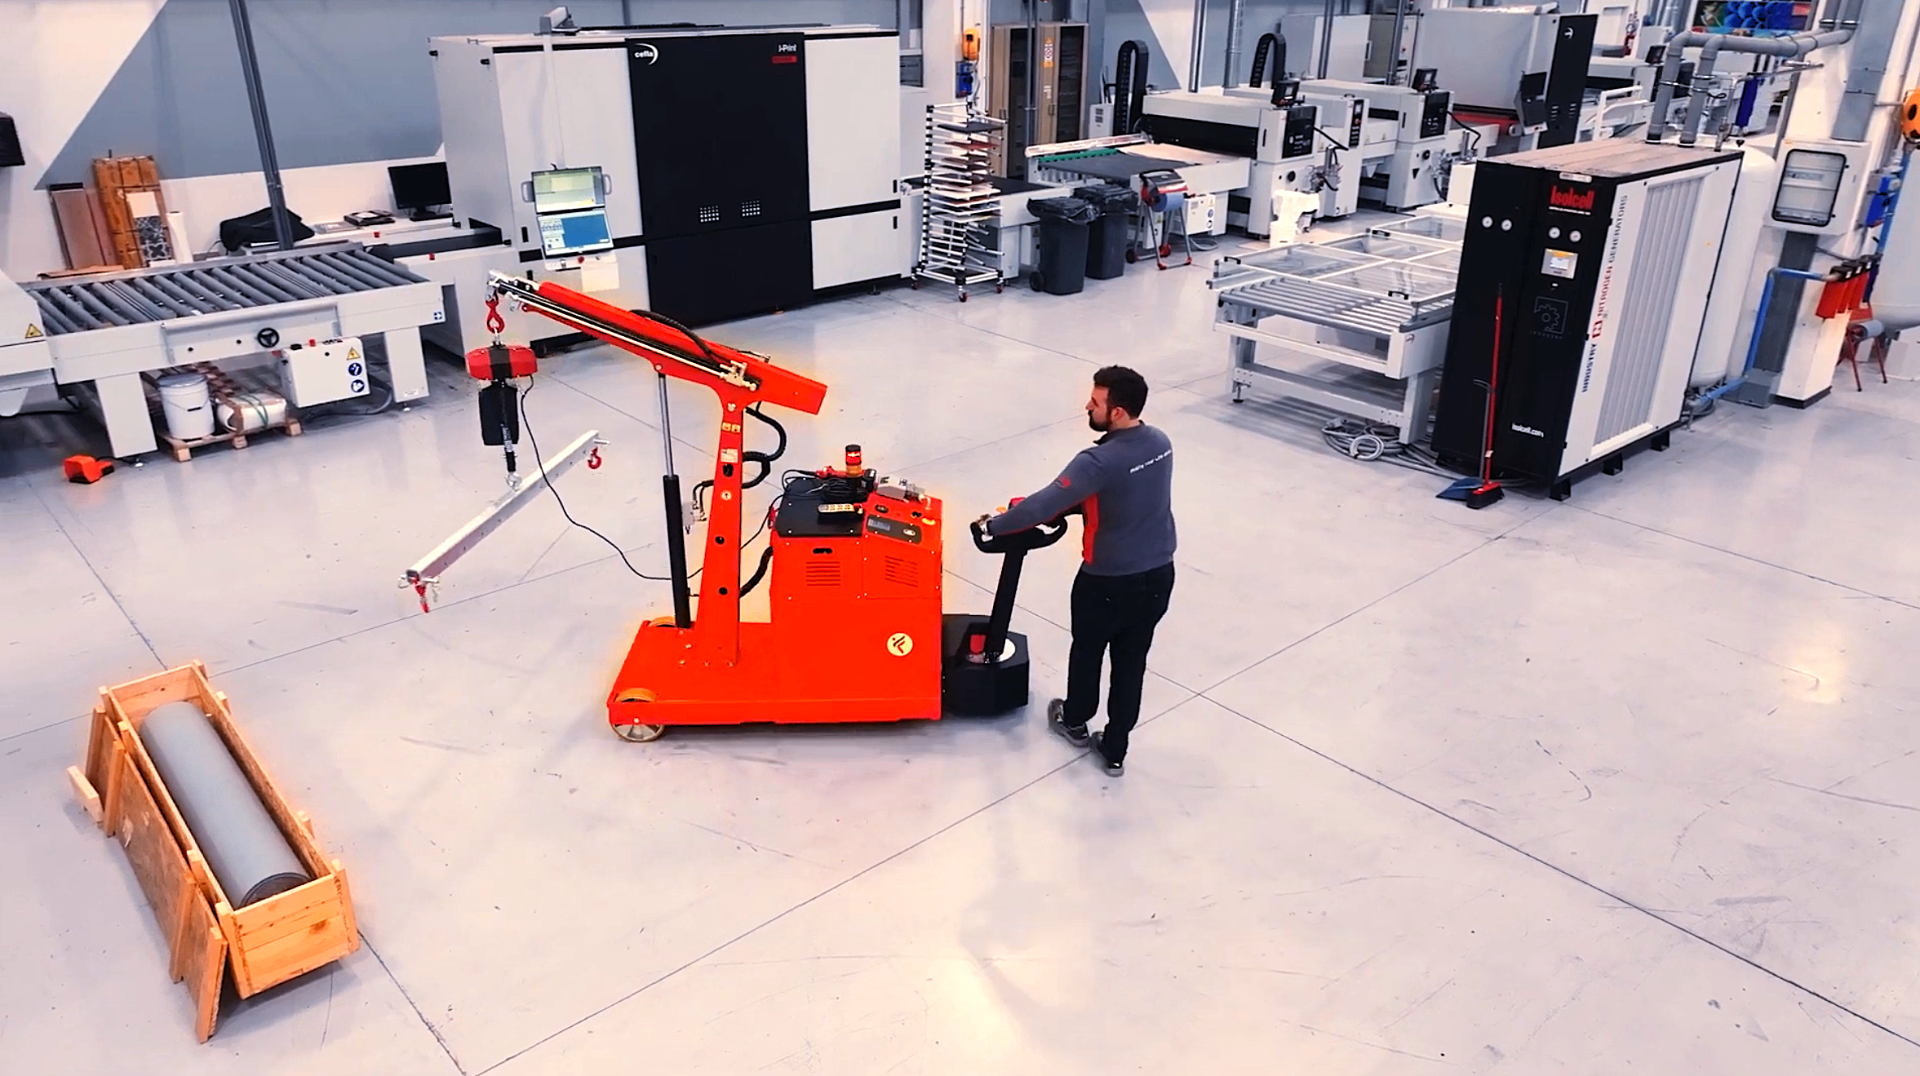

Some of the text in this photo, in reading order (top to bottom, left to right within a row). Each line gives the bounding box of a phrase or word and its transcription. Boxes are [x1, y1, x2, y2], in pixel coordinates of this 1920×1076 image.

[1581, 195, 1628, 393] INDUSTRY NITROGEN GENERATORS
